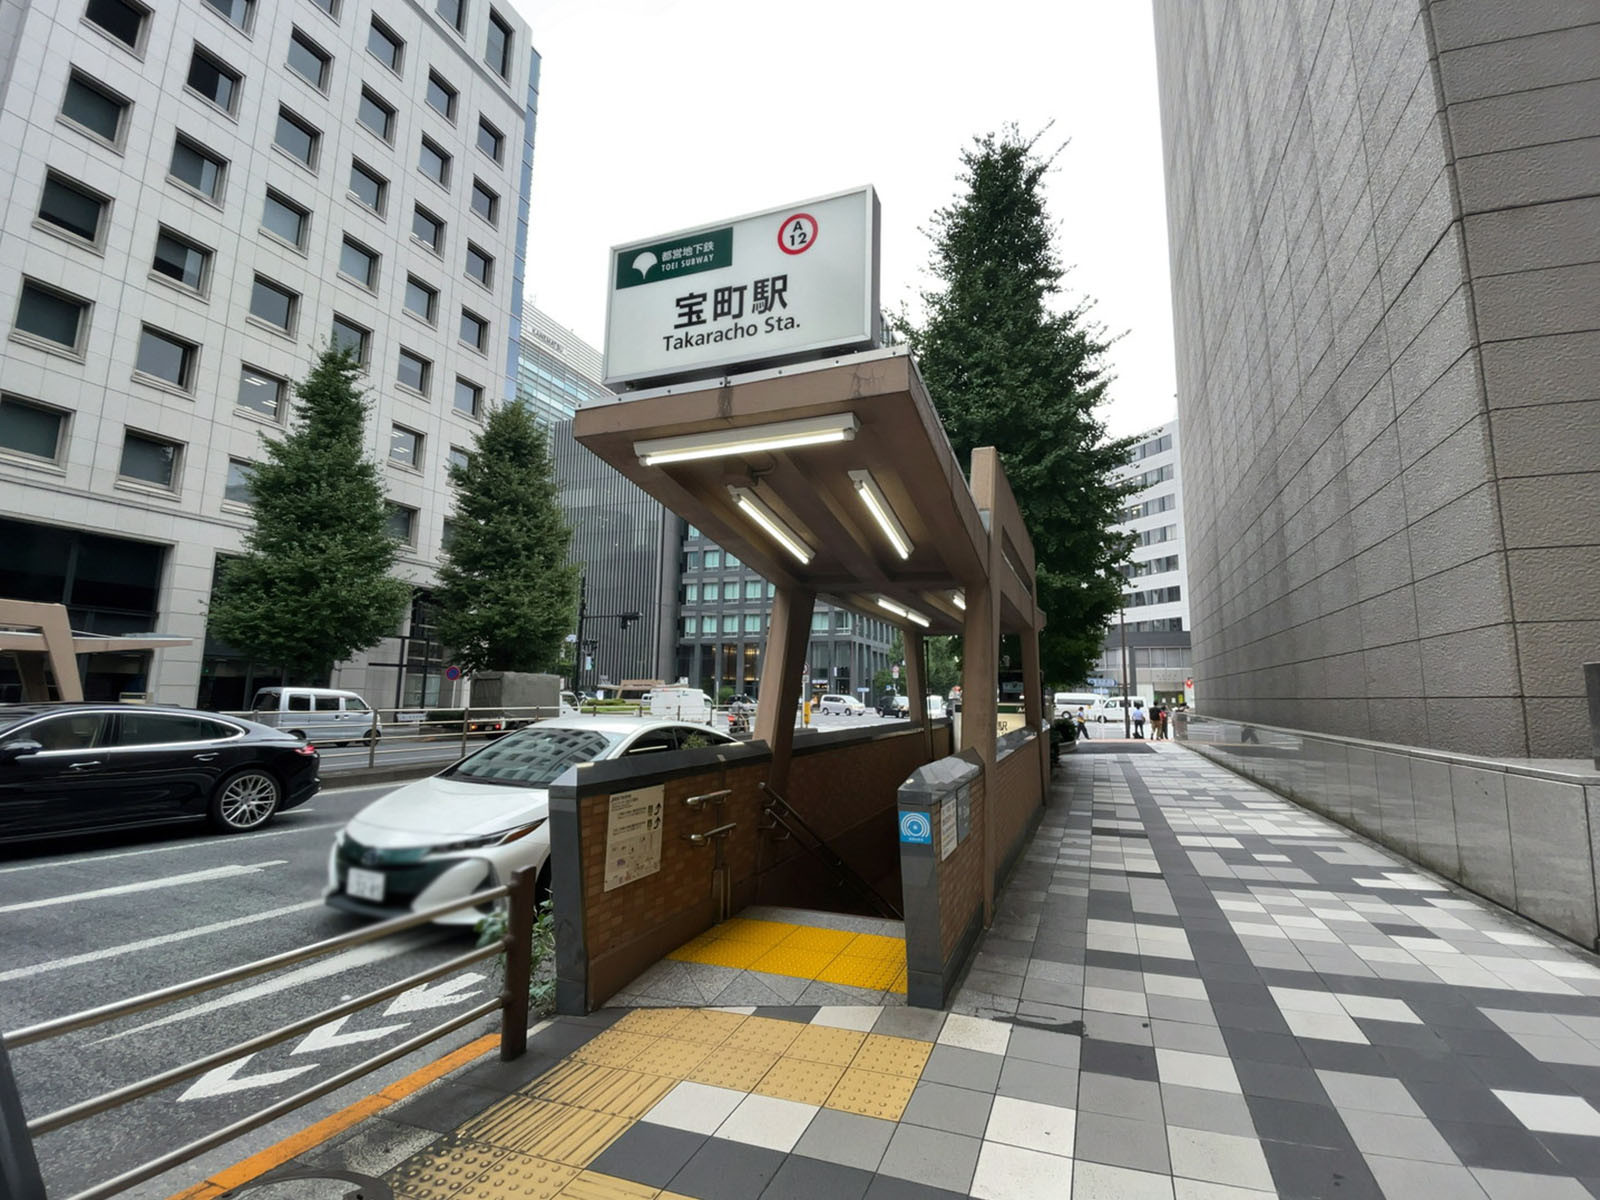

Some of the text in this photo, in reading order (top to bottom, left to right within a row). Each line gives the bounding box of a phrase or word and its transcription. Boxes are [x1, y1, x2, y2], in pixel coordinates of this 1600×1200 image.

[793, 221, 803, 232] A
[790, 232, 807, 246] 12
[661, 241, 714, 262] 都営地下鉄
[661, 254, 714, 272] TOEI SUBWAY
[673, 274, 788, 329] 宝町駅
[663, 315, 801, 351] Takaracho Sta.
